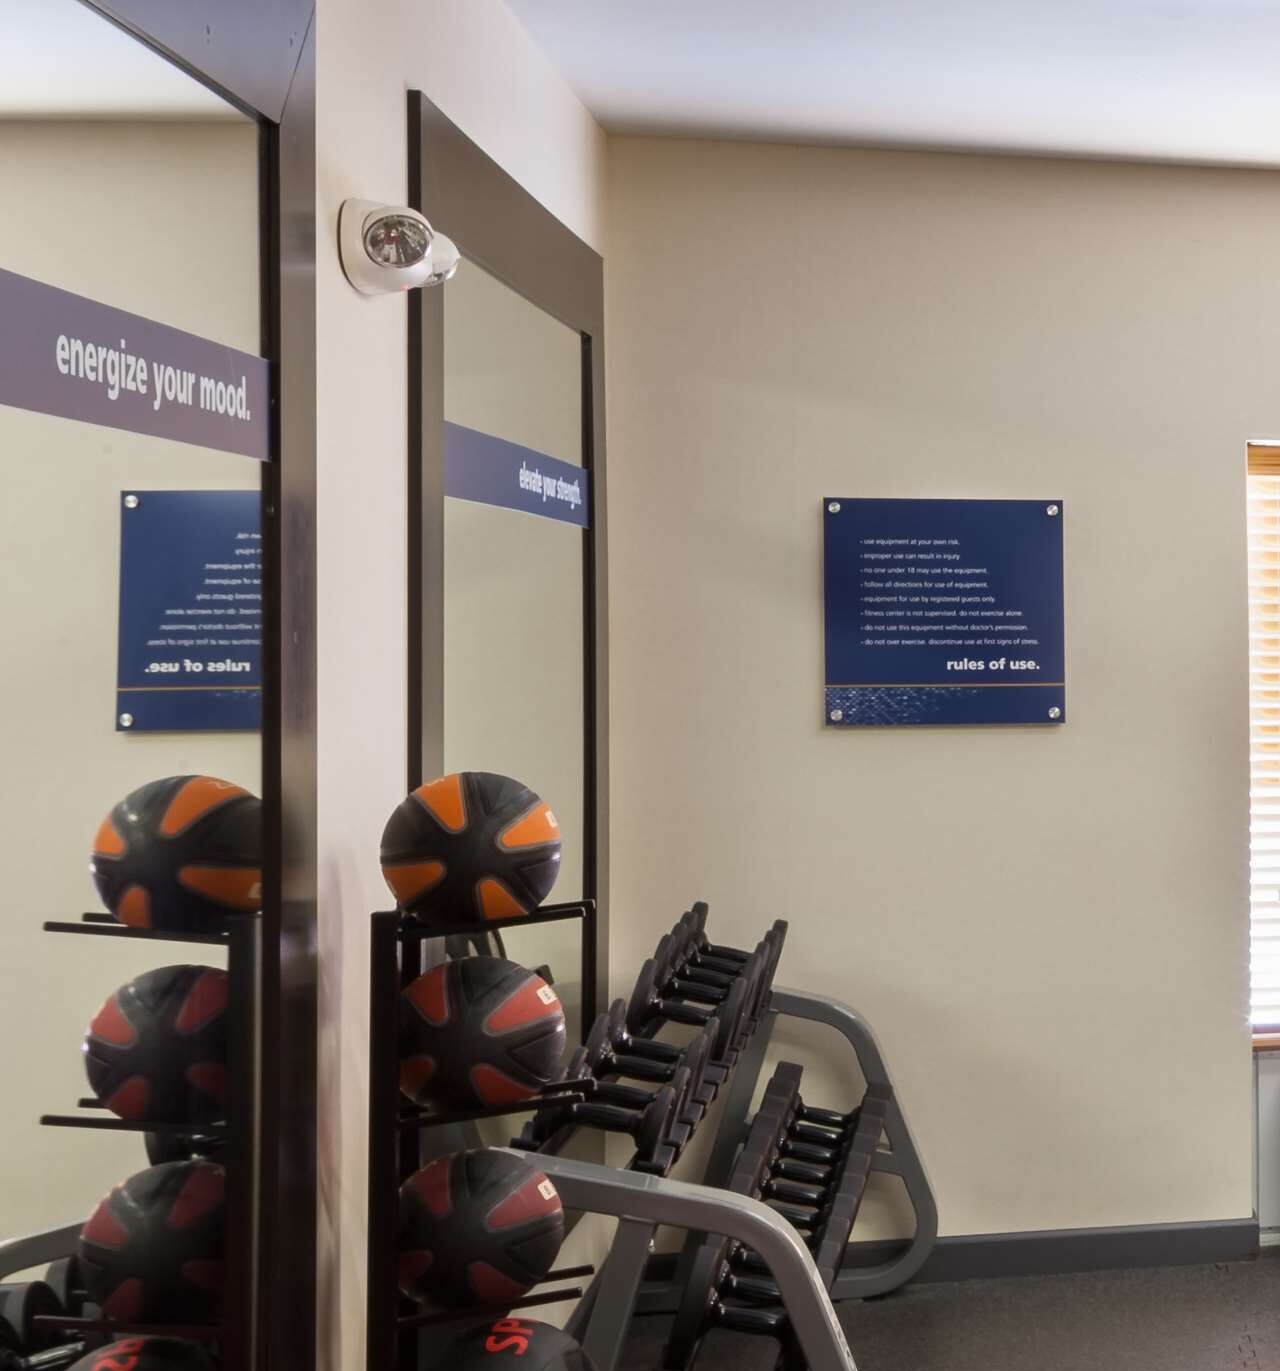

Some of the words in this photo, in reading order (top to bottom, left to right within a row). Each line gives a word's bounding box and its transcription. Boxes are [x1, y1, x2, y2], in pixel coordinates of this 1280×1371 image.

[56, 334, 148, 400] energize
[153, 362, 195, 410] your
[200, 376, 251, 420] mood.
[519, 461, 542, 494] elevate
[542, 475, 556, 502] your
[876, 539, 909, 547] equipment
[918, 539, 932, 547] your
[946, 658, 985, 670] rules
[989, 657, 1006, 670] of
[1009, 660, 1040, 670] use.
